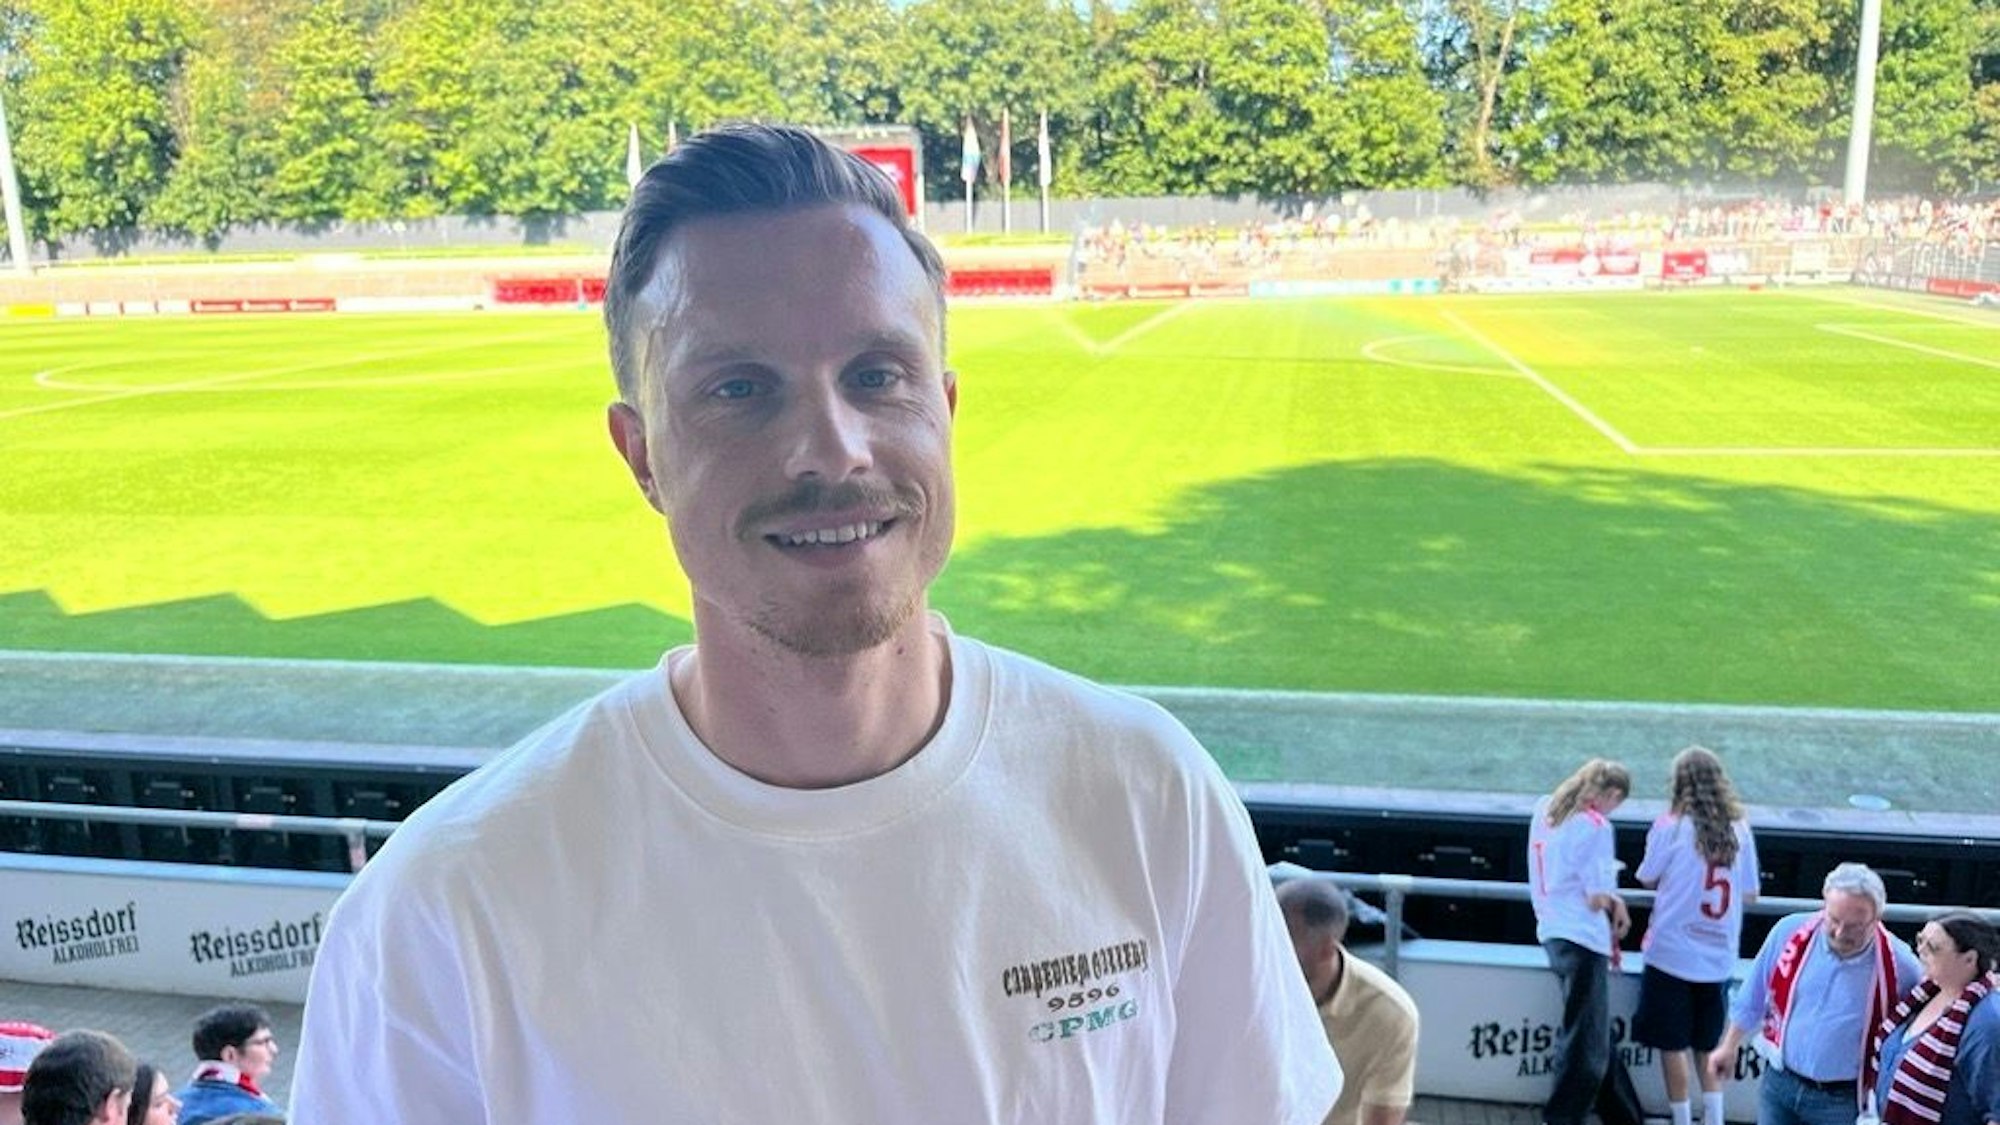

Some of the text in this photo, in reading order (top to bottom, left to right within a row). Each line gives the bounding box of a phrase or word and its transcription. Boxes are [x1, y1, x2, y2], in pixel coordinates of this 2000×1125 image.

[1700, 861, 1731, 920] 5
[15, 901, 137, 950] Reissdorf
[190, 912, 322, 963] Reissdorf
[53, 935, 140, 964] ALKOHOLFREI
[1029, 998, 1139, 1043] CPMG
[1047, 983, 1121, 1012] 9596
